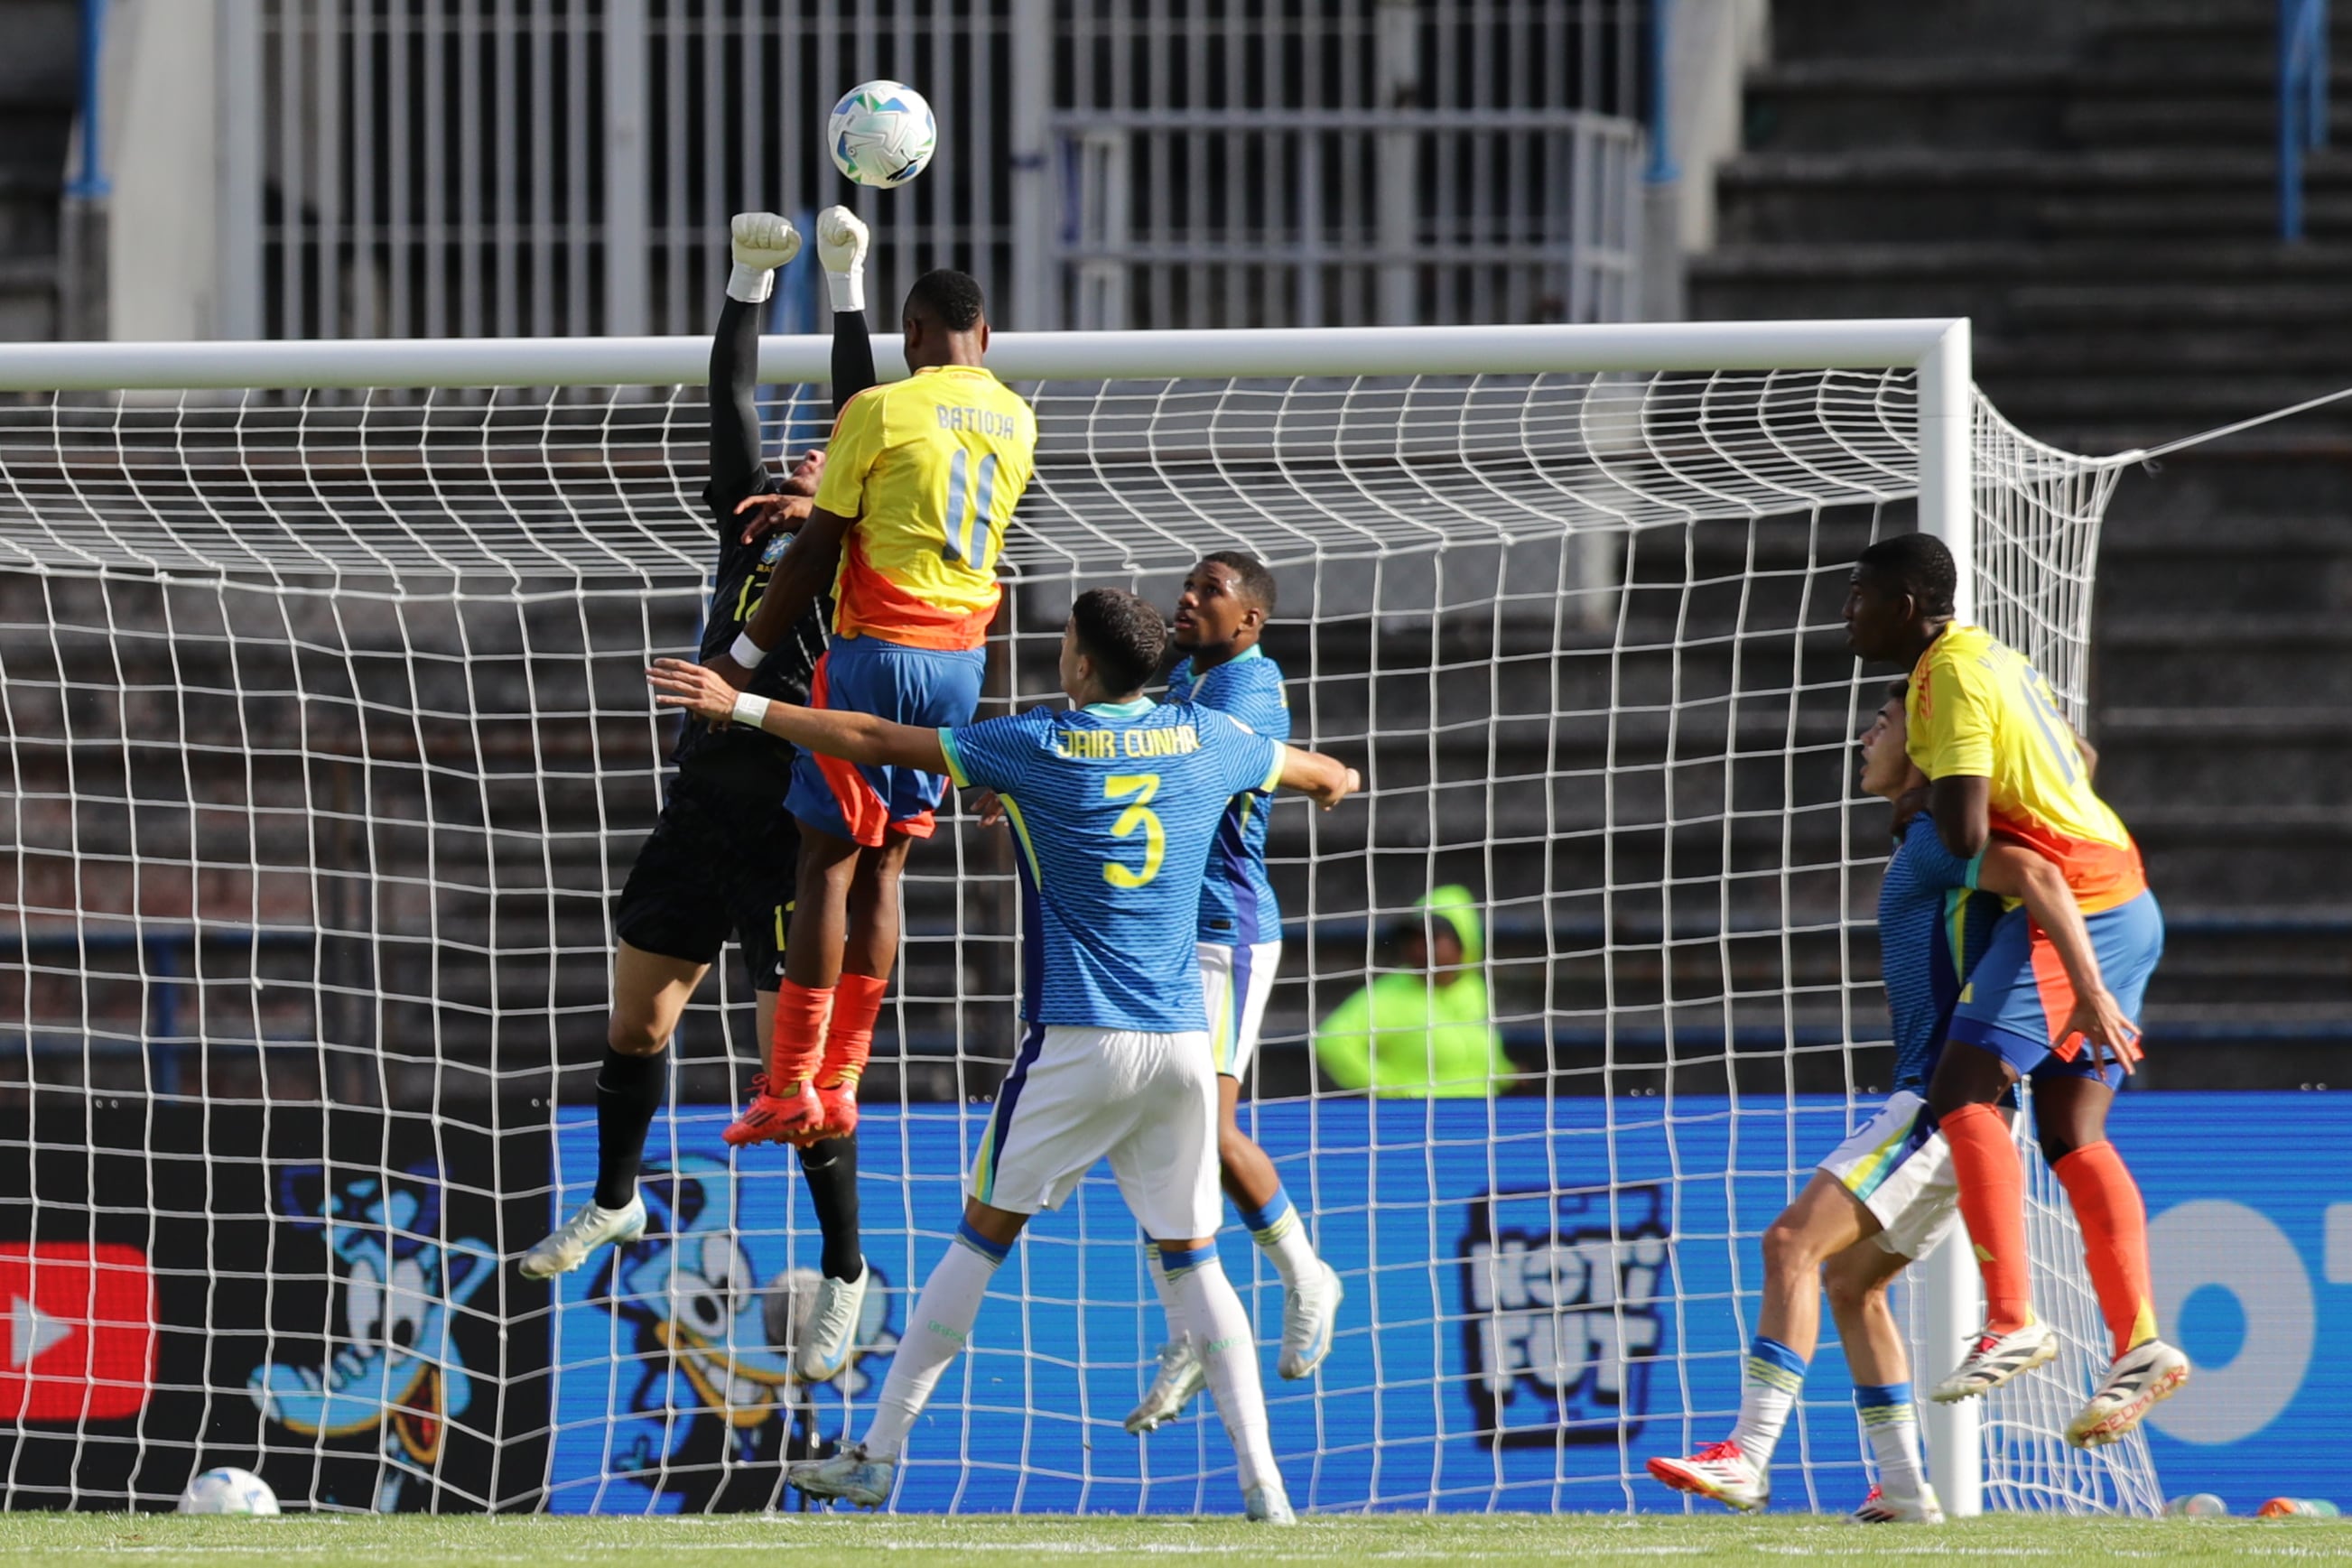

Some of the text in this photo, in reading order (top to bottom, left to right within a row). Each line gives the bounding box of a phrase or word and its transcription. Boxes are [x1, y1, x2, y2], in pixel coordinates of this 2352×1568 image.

[936, 404, 1014, 441] BATIOJA
[942, 448, 998, 570] 11
[1056, 725, 1202, 758] JAIR CUNHA
[1102, 773, 1166, 889] 3
[1479, 1313, 1659, 1393] FUT
